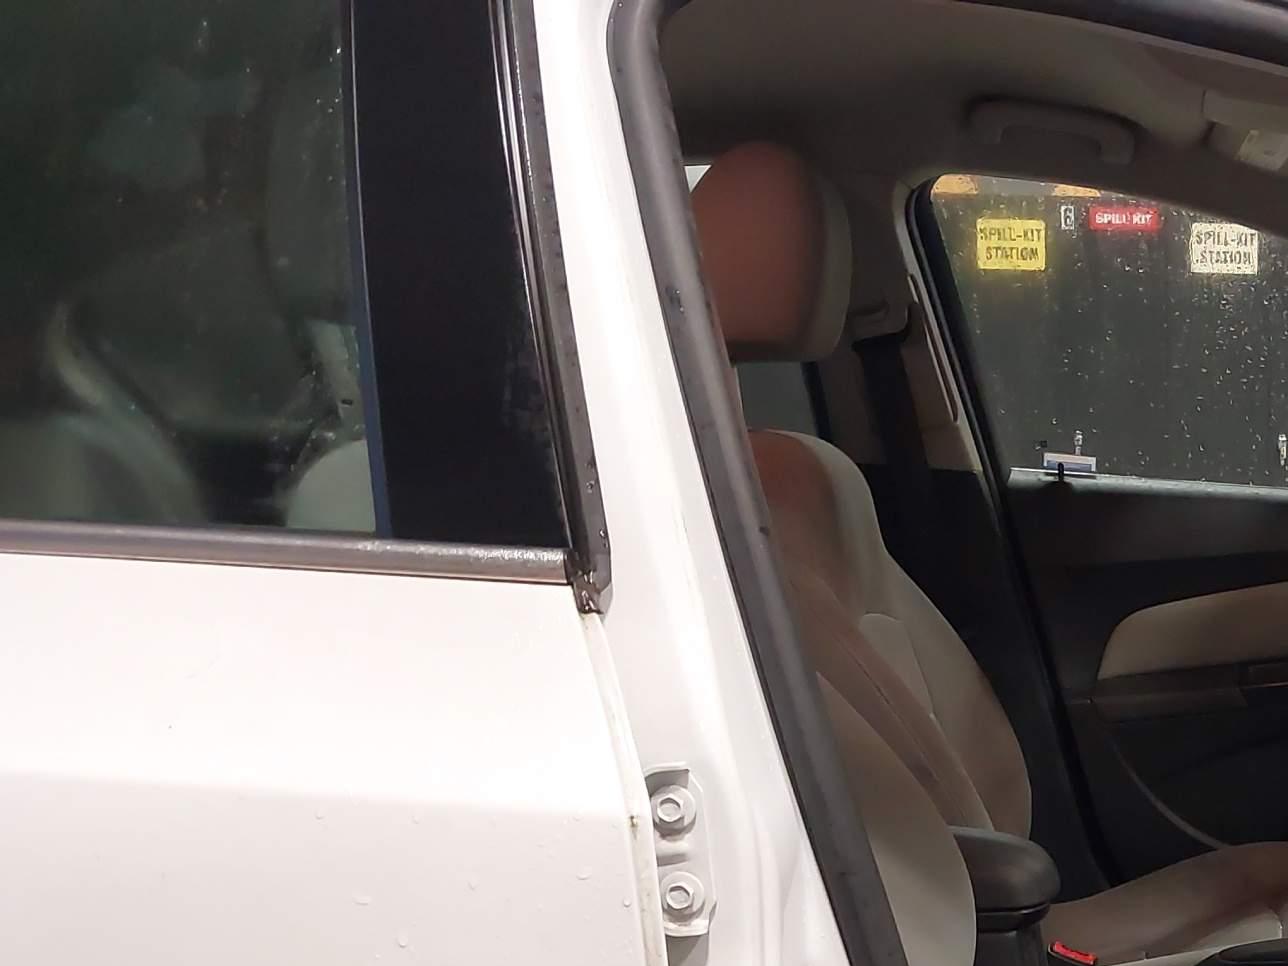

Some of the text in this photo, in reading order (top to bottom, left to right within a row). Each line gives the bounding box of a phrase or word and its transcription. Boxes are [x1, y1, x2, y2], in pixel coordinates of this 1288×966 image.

[1095, 212, 1153, 225] SPILL KIT
[979, 228, 1042, 242] SPILL-KIT
[1195, 230, 1257, 247] SPILL-KIT
[985, 246, 1040, 261] STATION
[1199, 250, 1252, 265] STATION
